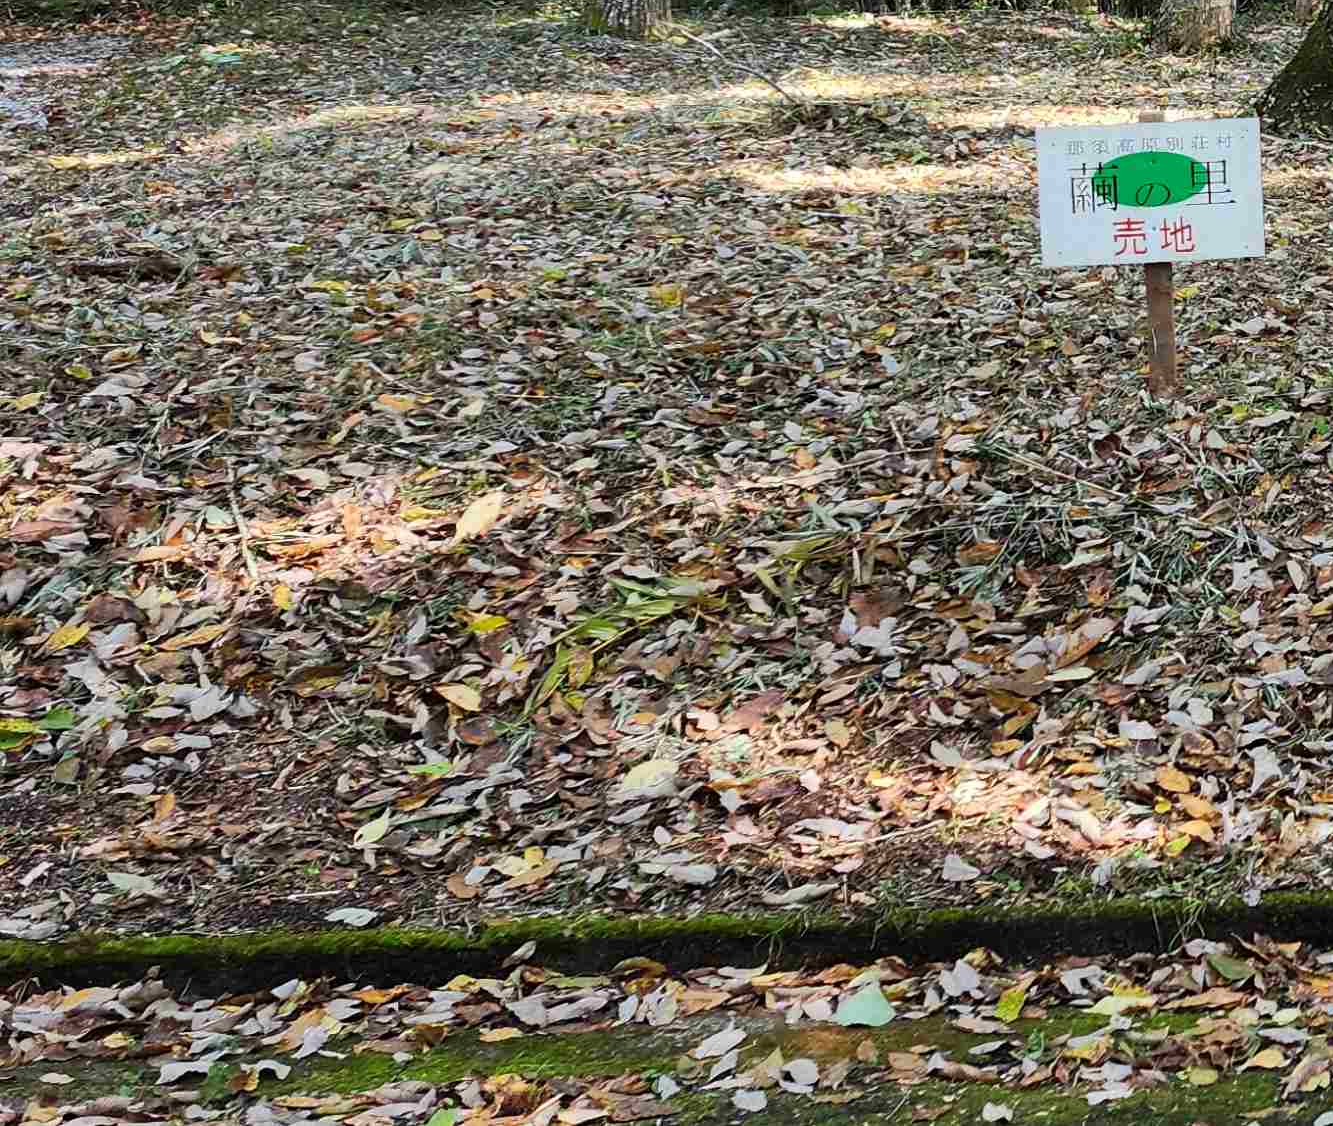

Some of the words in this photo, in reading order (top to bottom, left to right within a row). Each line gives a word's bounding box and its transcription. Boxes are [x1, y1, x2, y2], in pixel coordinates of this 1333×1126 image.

[1067, 160, 1236, 213] 繭の里
[1112, 217, 1195, 256] 売地
